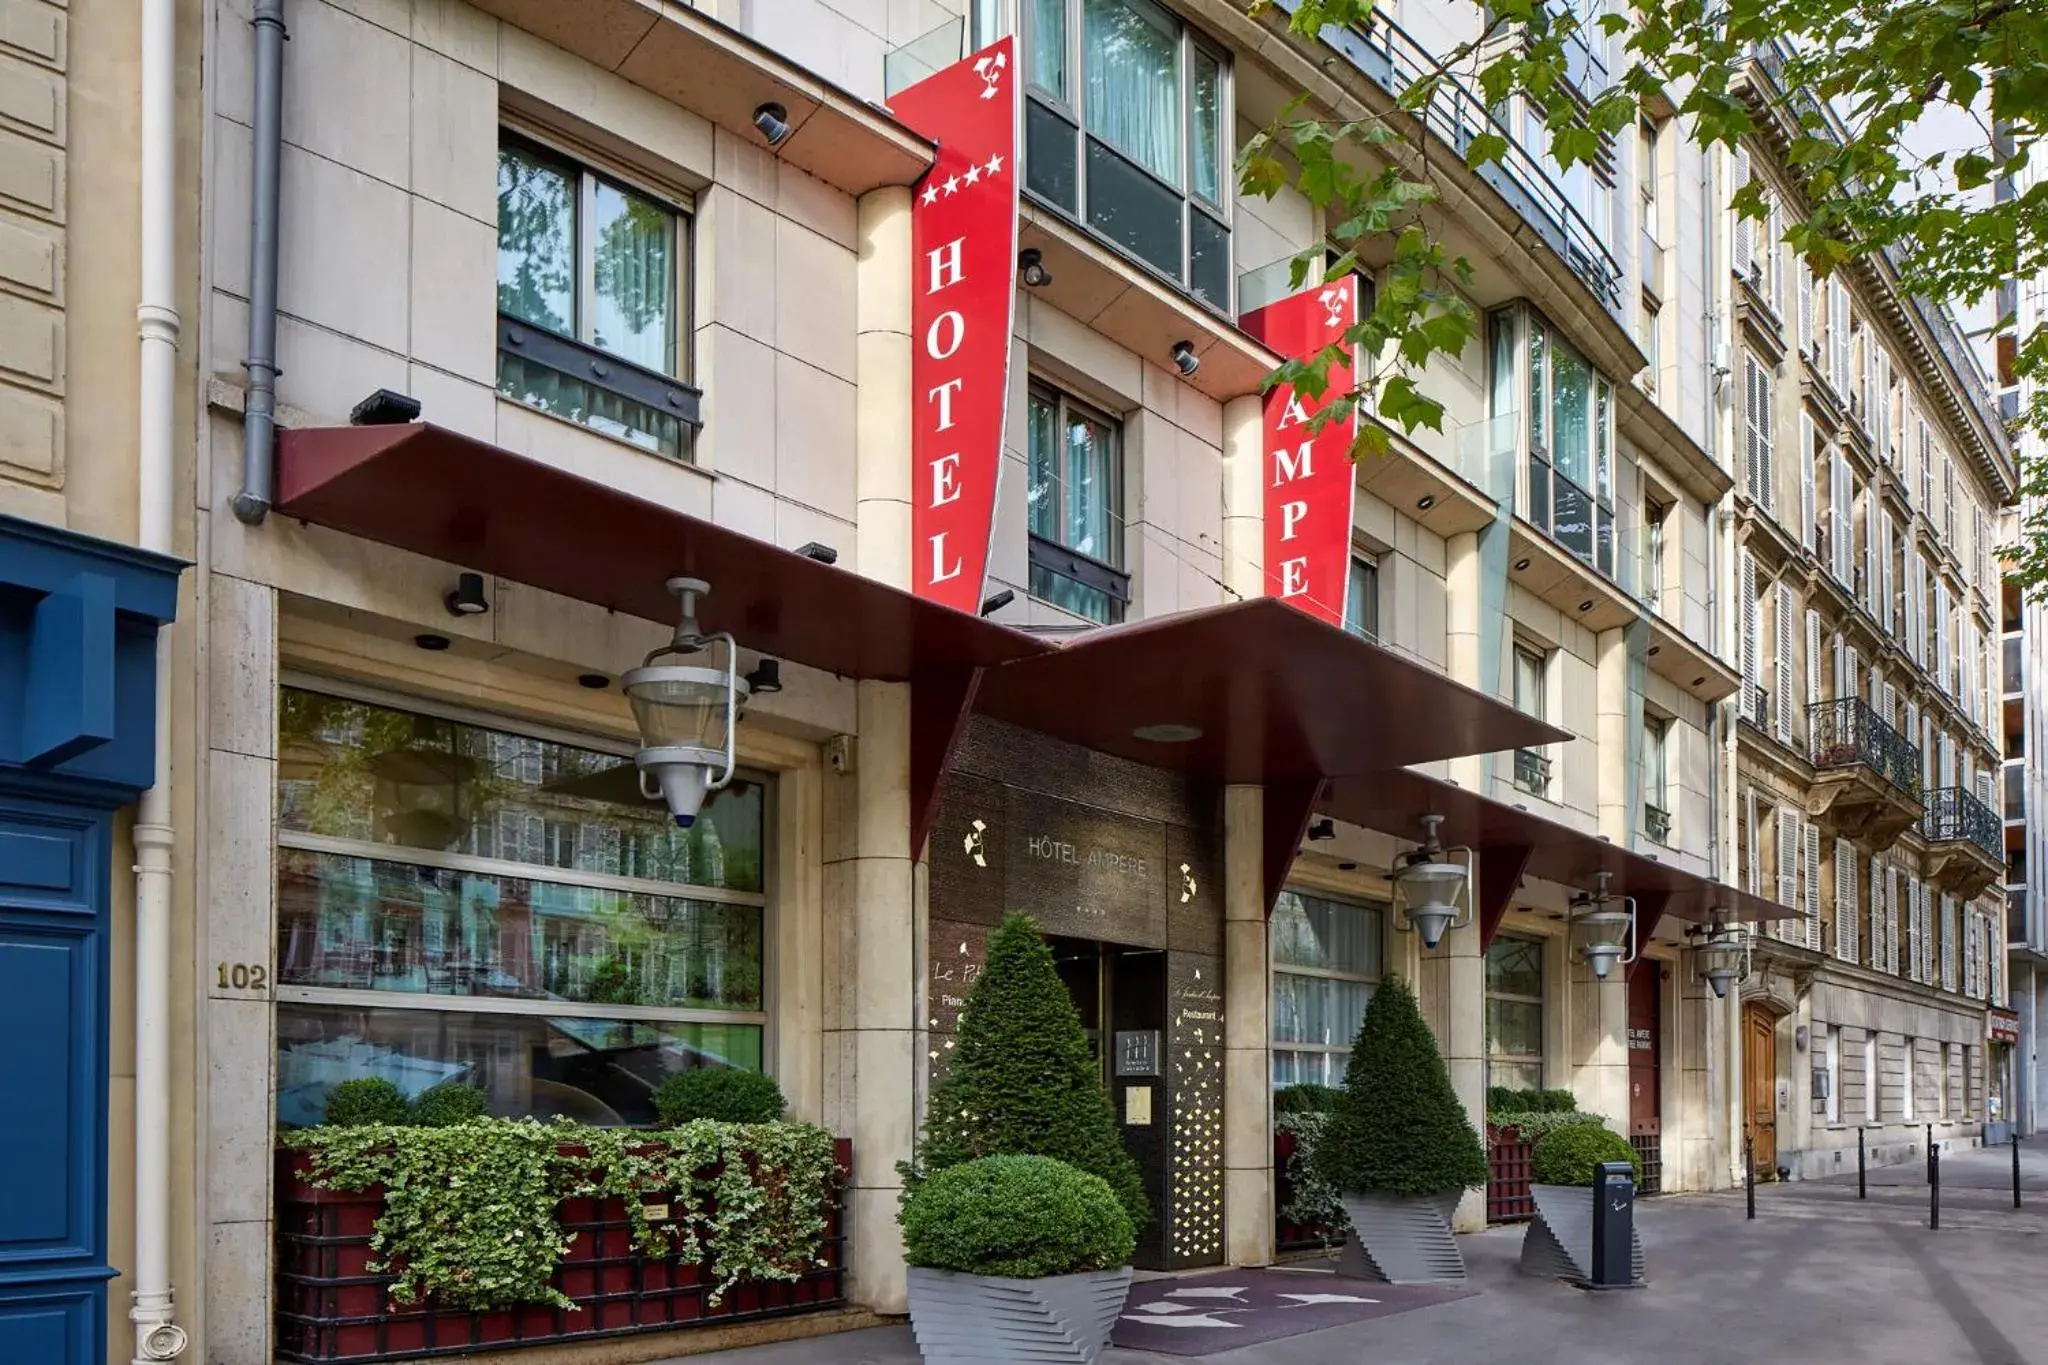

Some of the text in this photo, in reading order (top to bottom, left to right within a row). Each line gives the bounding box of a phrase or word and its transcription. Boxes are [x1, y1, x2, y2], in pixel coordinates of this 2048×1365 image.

[925, 236, 965, 586] HOTEL
[217, 961, 267, 990] 102
[934, 962, 954, 981] Le
